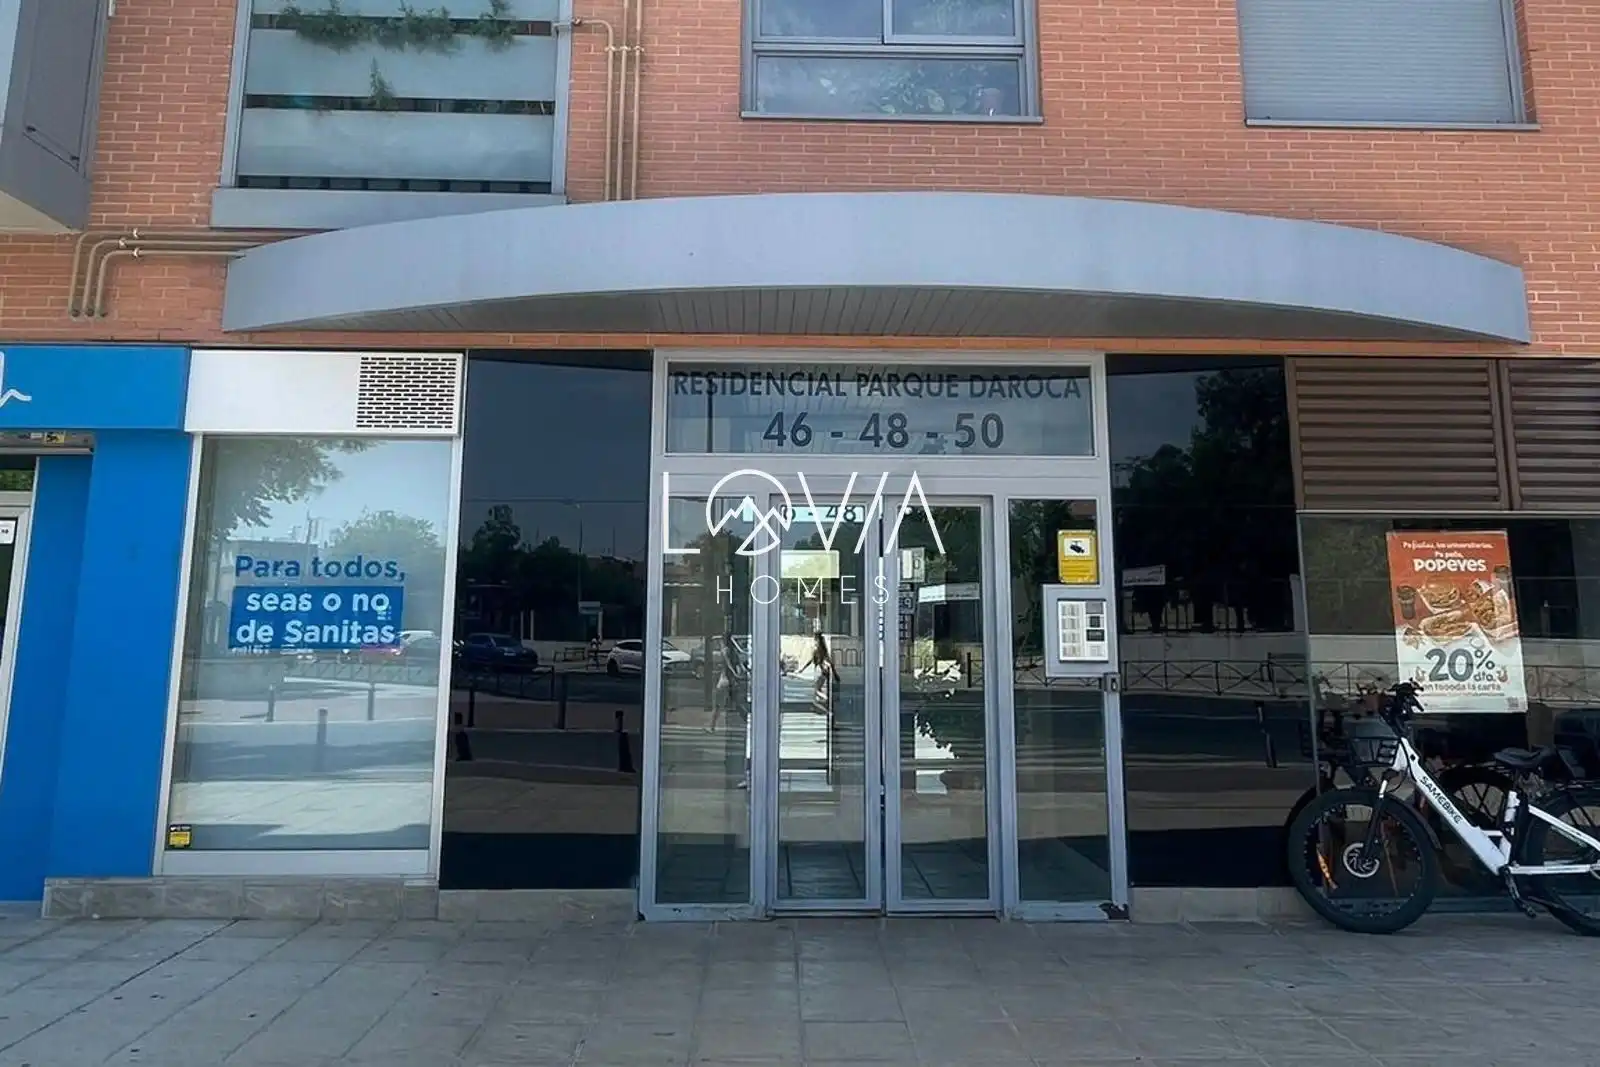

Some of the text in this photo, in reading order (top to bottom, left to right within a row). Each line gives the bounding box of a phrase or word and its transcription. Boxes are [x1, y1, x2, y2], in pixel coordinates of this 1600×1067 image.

[673, 371, 1081, 400] RESIDENCIAL PARQUE DAROCA
[763, 412, 812, 447] 46
[858, 413, 909, 448] 48
[955, 413, 1005, 448] 50
[235, 555, 406, 582] Para todos,
[246, 591, 390, 613] seas o no
[236, 618, 396, 644] de Sanitas
[1425, 648, 1496, 682] 20%
[1419, 776, 1463, 825] SAMEBIKE
